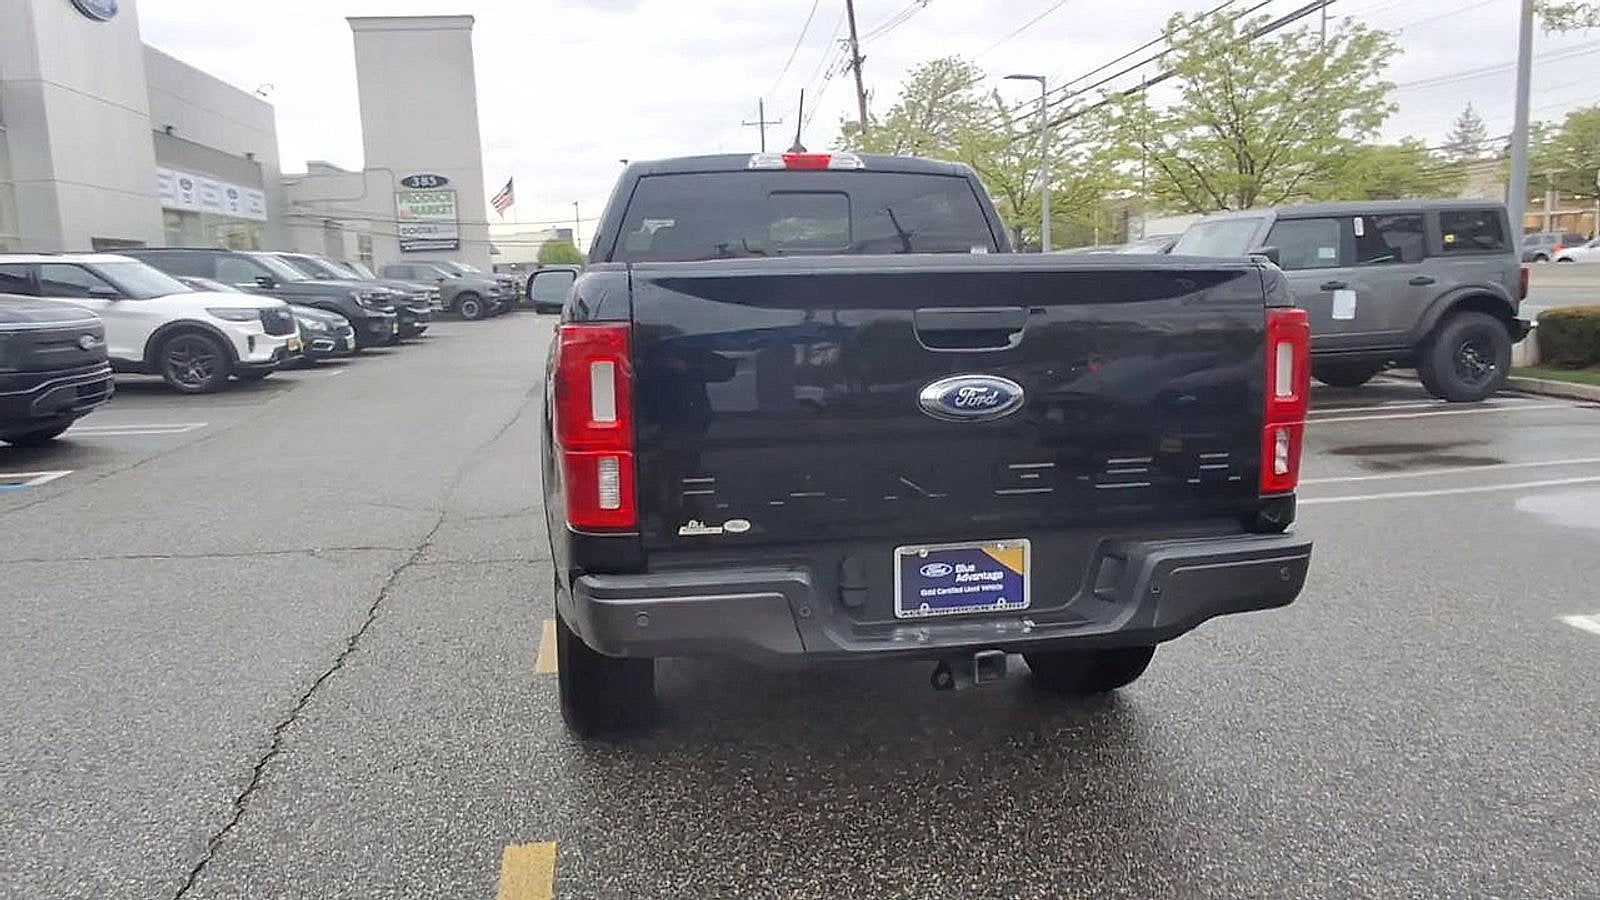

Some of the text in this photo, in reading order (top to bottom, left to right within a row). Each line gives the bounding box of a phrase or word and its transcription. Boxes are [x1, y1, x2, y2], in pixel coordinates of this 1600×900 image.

[955, 387, 999, 407] Ford
[955, 563, 976, 573] Blue
[955, 571, 1004, 583] Advantage
